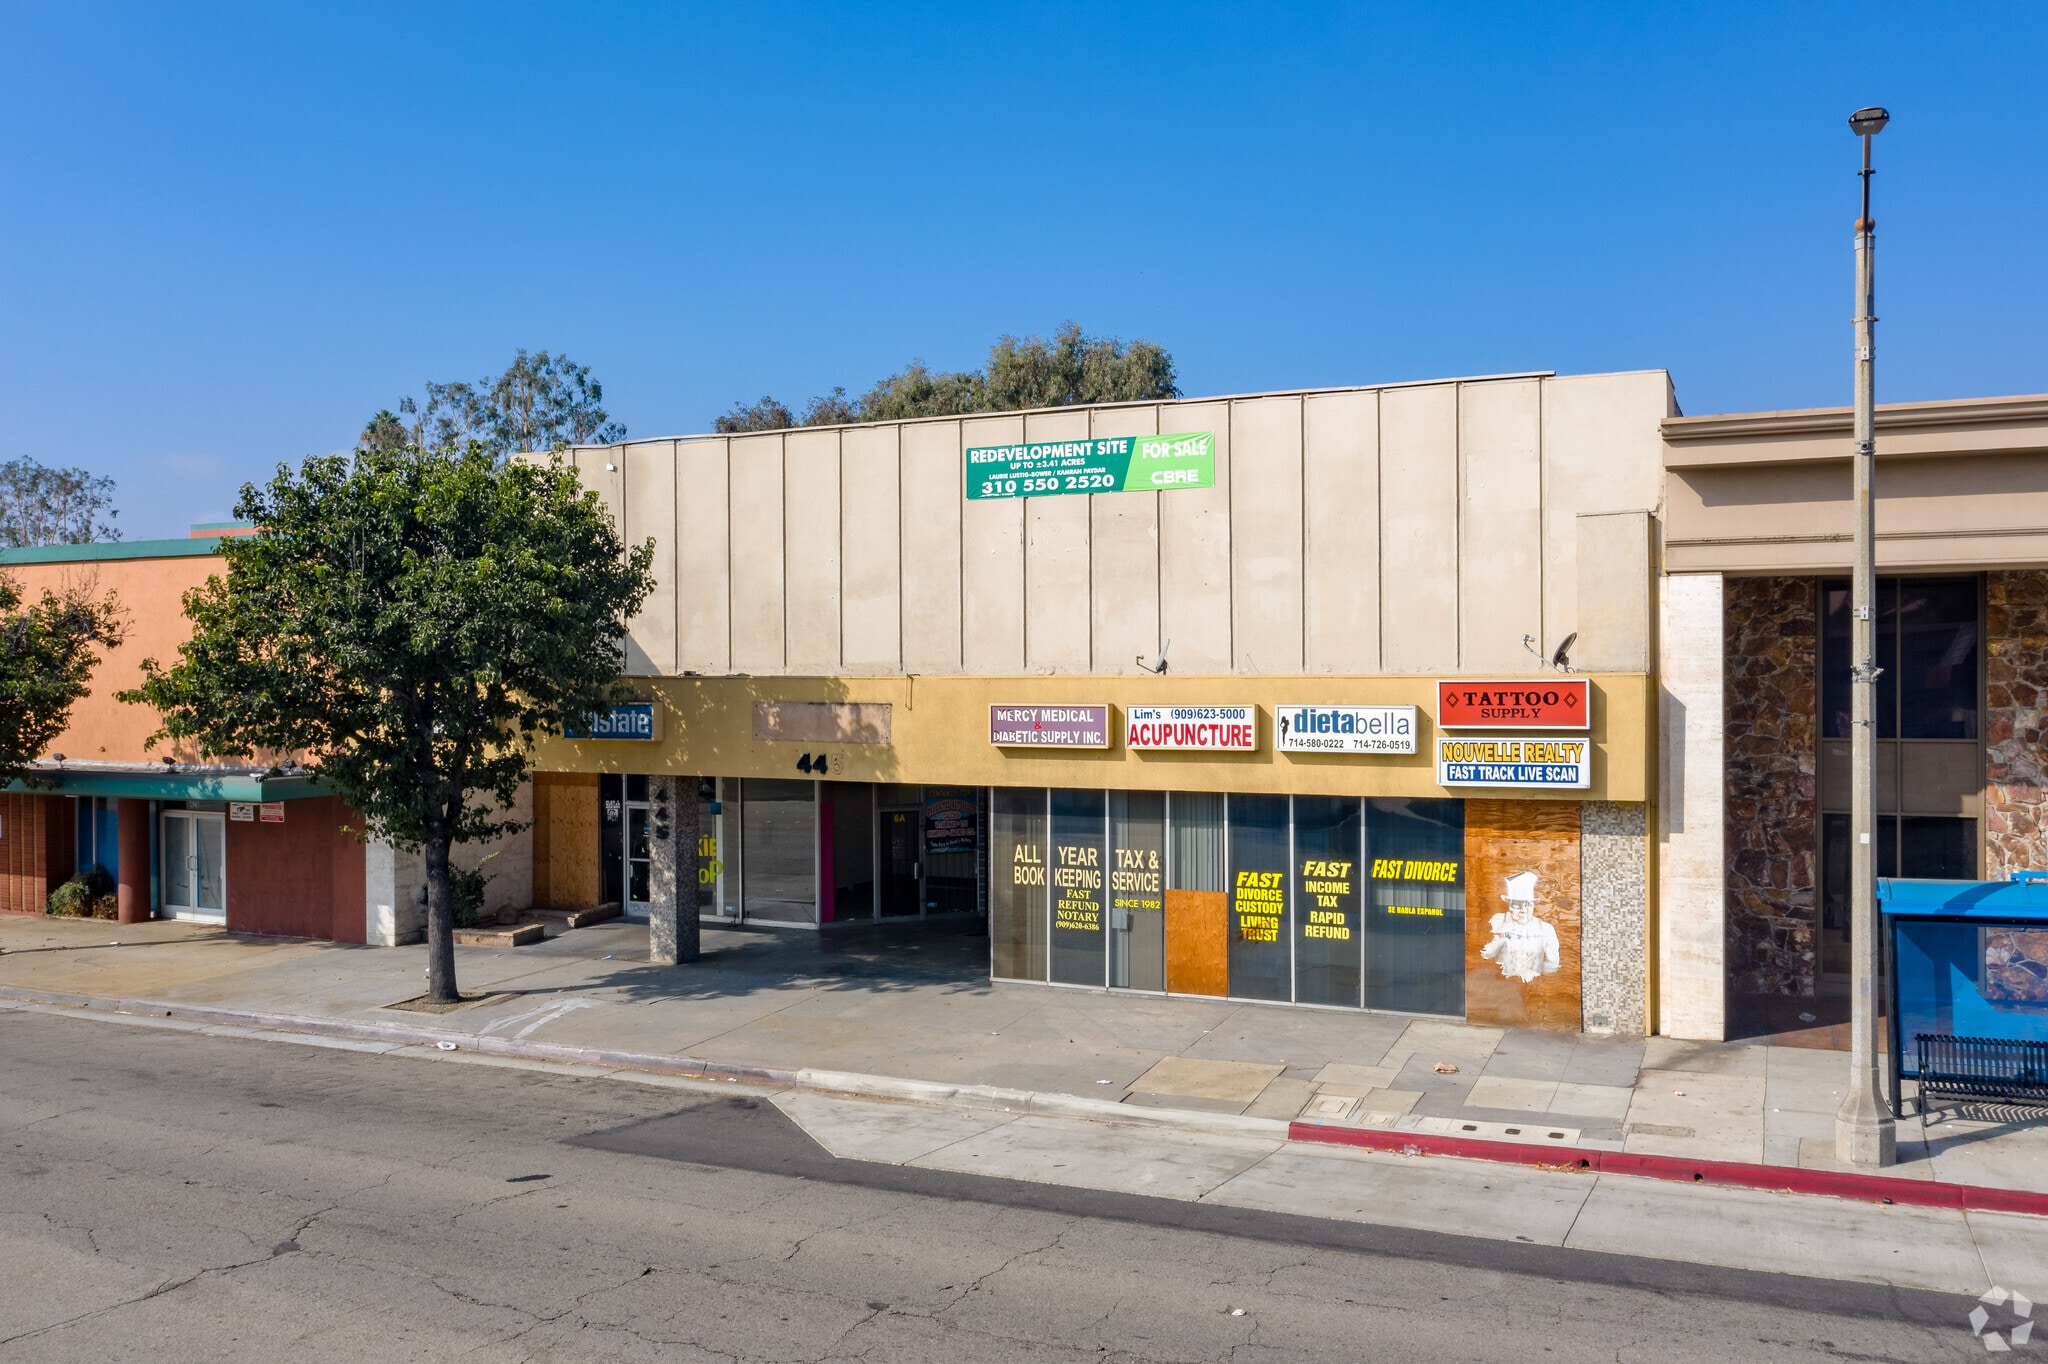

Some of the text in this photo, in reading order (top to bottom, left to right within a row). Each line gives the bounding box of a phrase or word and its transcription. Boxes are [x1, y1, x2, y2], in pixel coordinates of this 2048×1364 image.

[971, 440, 1128, 463] REDEVELOPMENT SITE
[1142, 440, 1207, 459] FOR SALE
[1010, 457, 1086, 470] UP TO ±3.41 ACRES
[1083, 466, 1106, 474] PAYDAR
[1151, 469, 1199, 484] CBRE
[981, 474, 1115, 494] 310 550 2520
[1463, 690, 1559, 706] TATTOO
[997, 709, 1094, 722] MERCY MEDICAL
[1134, 708, 1246, 719] Lim's (909)623-5000
[1480, 708, 1541, 718] SUPPLY
[1034, 721, 1043, 730] &
[1294, 709, 1409, 735] dietabella
[993, 730, 1104, 744] DIABETIC SUPPLY INC.
[1128, 724, 1252, 746] ACUPUNCTURE
[1289, 738, 1411, 749] 714-580-0222 714-726-0519
[1442, 743, 1584, 763] NOUVELLE REALTY
[1450, 765, 1577, 781] FAST TRACK LIVE SCAN
[1014, 844, 1160, 869] ALL YEAR TAX &
[1303, 861, 1351, 878] FAST
[1372, 859, 1458, 882] FAST DIVORCE
[1014, 866, 1160, 891] BOOK KEEPING SERVICE
[1236, 871, 1283, 889] FAST
[1066, 889, 1091, 899] FAST
[1236, 888, 1283, 901] DIVORCE
[1305, 881, 1350, 894] INCOME
[1058, 900, 1099, 911] REFUND
[1114, 898, 1161, 909] SINCE 1982
[1235, 900, 1284, 915] CUSTODY
[1317, 895, 1338, 908] TAX
[1057, 910, 1099, 922] NOTARY
[1387, 906, 1396, 914] SE
[1240, 915, 1279, 929] LIVING
[1310, 911, 1345, 925] RAPID
[1055, 921, 1099, 931] (909)620-6386
[1305, 925, 1350, 940] REFUND
[1241, 928, 1278, 942] TRUST
